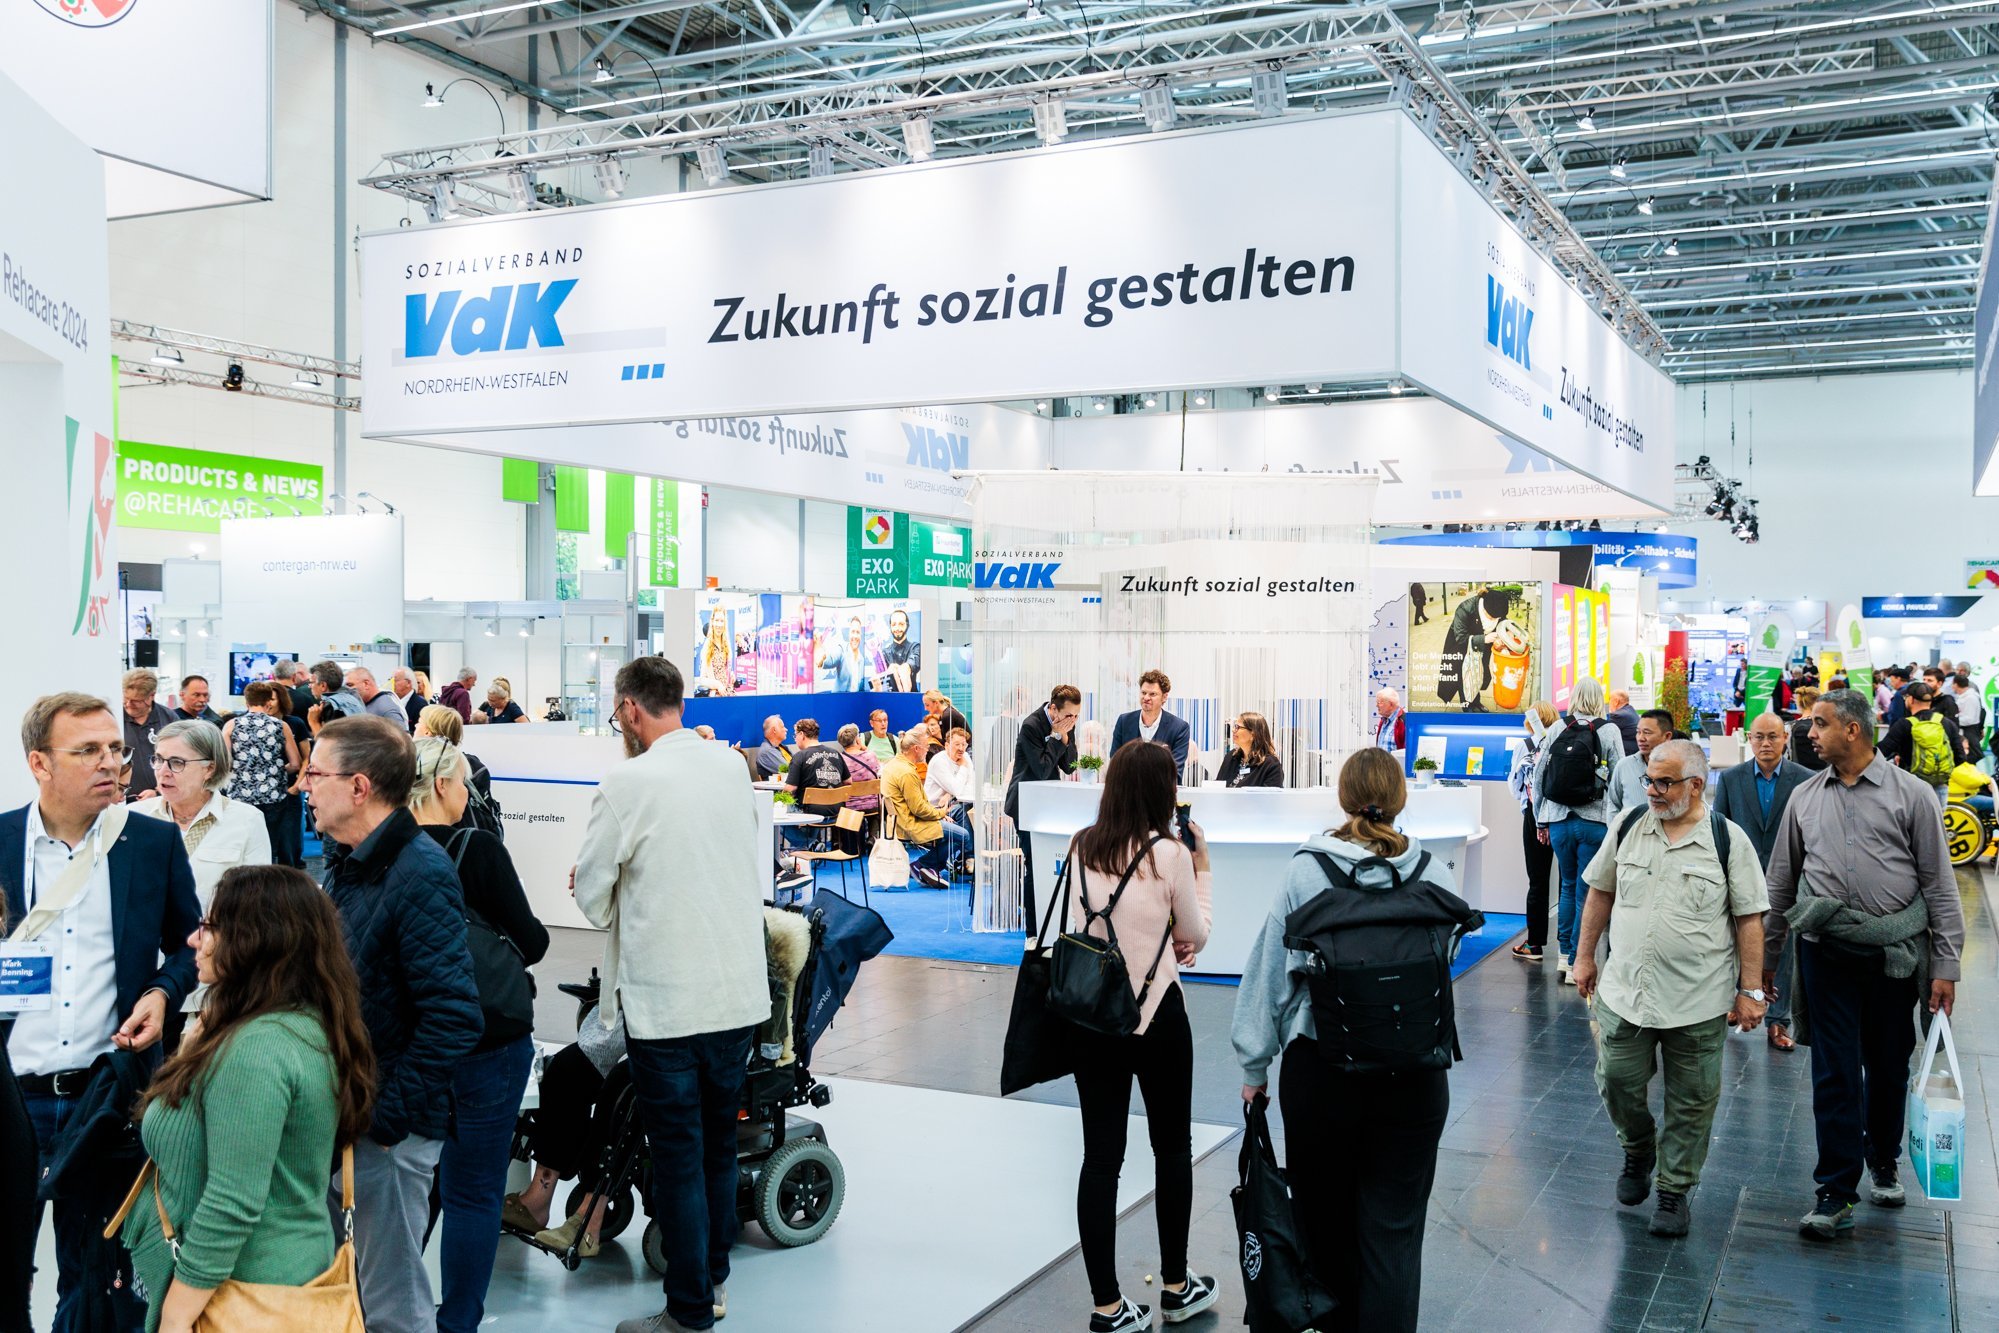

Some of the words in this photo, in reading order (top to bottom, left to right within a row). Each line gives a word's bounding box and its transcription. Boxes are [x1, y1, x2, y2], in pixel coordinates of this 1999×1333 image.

[405, 246, 584, 280] SOZIALVERBAND
[3, 251, 60, 332] Rehacare
[62, 301, 88, 354] 2024
[706, 282, 901, 346] Zukunft
[916, 265, 1068, 328] sozial
[1083, 247, 1356, 329] gestalten
[404, 278, 580, 358] VdK
[1487, 272, 1534, 372] VdK
[404, 369, 569, 396] NORDRHEIN-WESTFALEN
[1559, 365, 1593, 429] Zukunft
[1593, 400, 1614, 436] sozial
[1614, 416, 1645, 454] gestalten
[123, 457, 239, 491] PRODUCTS
[242, 472, 258, 492] &
[262, 474, 320, 498] NEWS
[656, 479, 665, 508] NEW
[123, 490, 258, 520] @REHACARE
[656, 511, 665, 519] &
[656, 521, 665, 582] PRODUCTS
[975, 550, 1064, 558] SOZIALVERBAND
[1594, 544, 1626, 555] bilität
[262, 558, 358, 575] contergan-nrw.eu
[861, 557, 894, 575] EXO
[924, 558, 945, 577] EXO
[946, 561, 973, 580] PARK
[974, 562, 1062, 589] VdK
[856, 577, 900, 595] PARK
[1120, 575, 1199, 597] Zukunft
[1205, 576, 1261, 593] sozial
[1266, 576, 1356, 598] gestalten
[1412, 651, 1430, 661] Der
[1431, 651, 1464, 661] Mensch
[1430, 662, 1453, 672] nicht
[1432, 673, 1459, 682] Pfand
[1411, 700, 1445, 708] Endstation
[503, 811, 527, 821] sozial
[528, 813, 565, 824] gestalten
[1, 968, 34, 977] Benning
[2, 960, 22, 968] Mark
